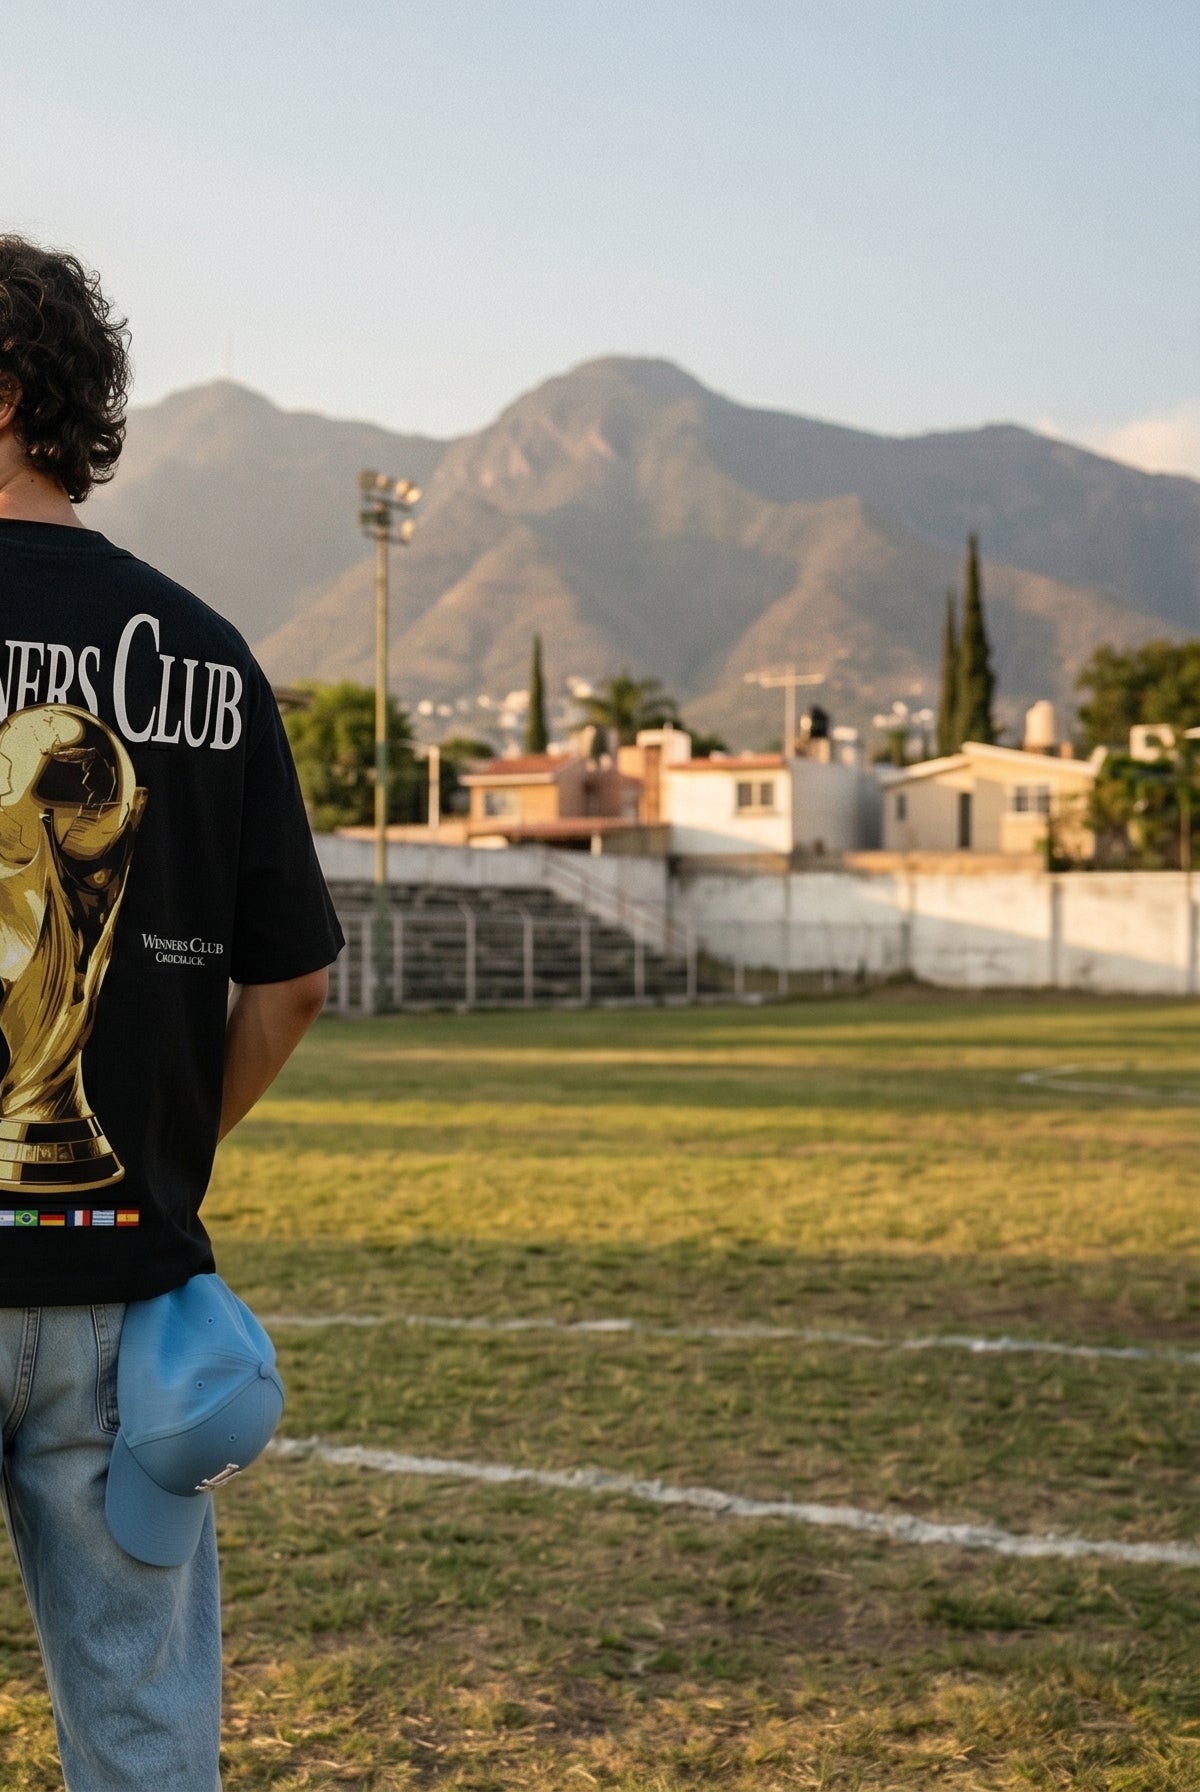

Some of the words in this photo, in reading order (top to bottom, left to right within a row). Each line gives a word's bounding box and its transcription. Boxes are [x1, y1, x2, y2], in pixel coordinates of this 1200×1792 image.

[114, 614, 242, 749] CLUB
[141, 933, 188, 952] WINNERS
[189, 937, 224, 954] CLUB
